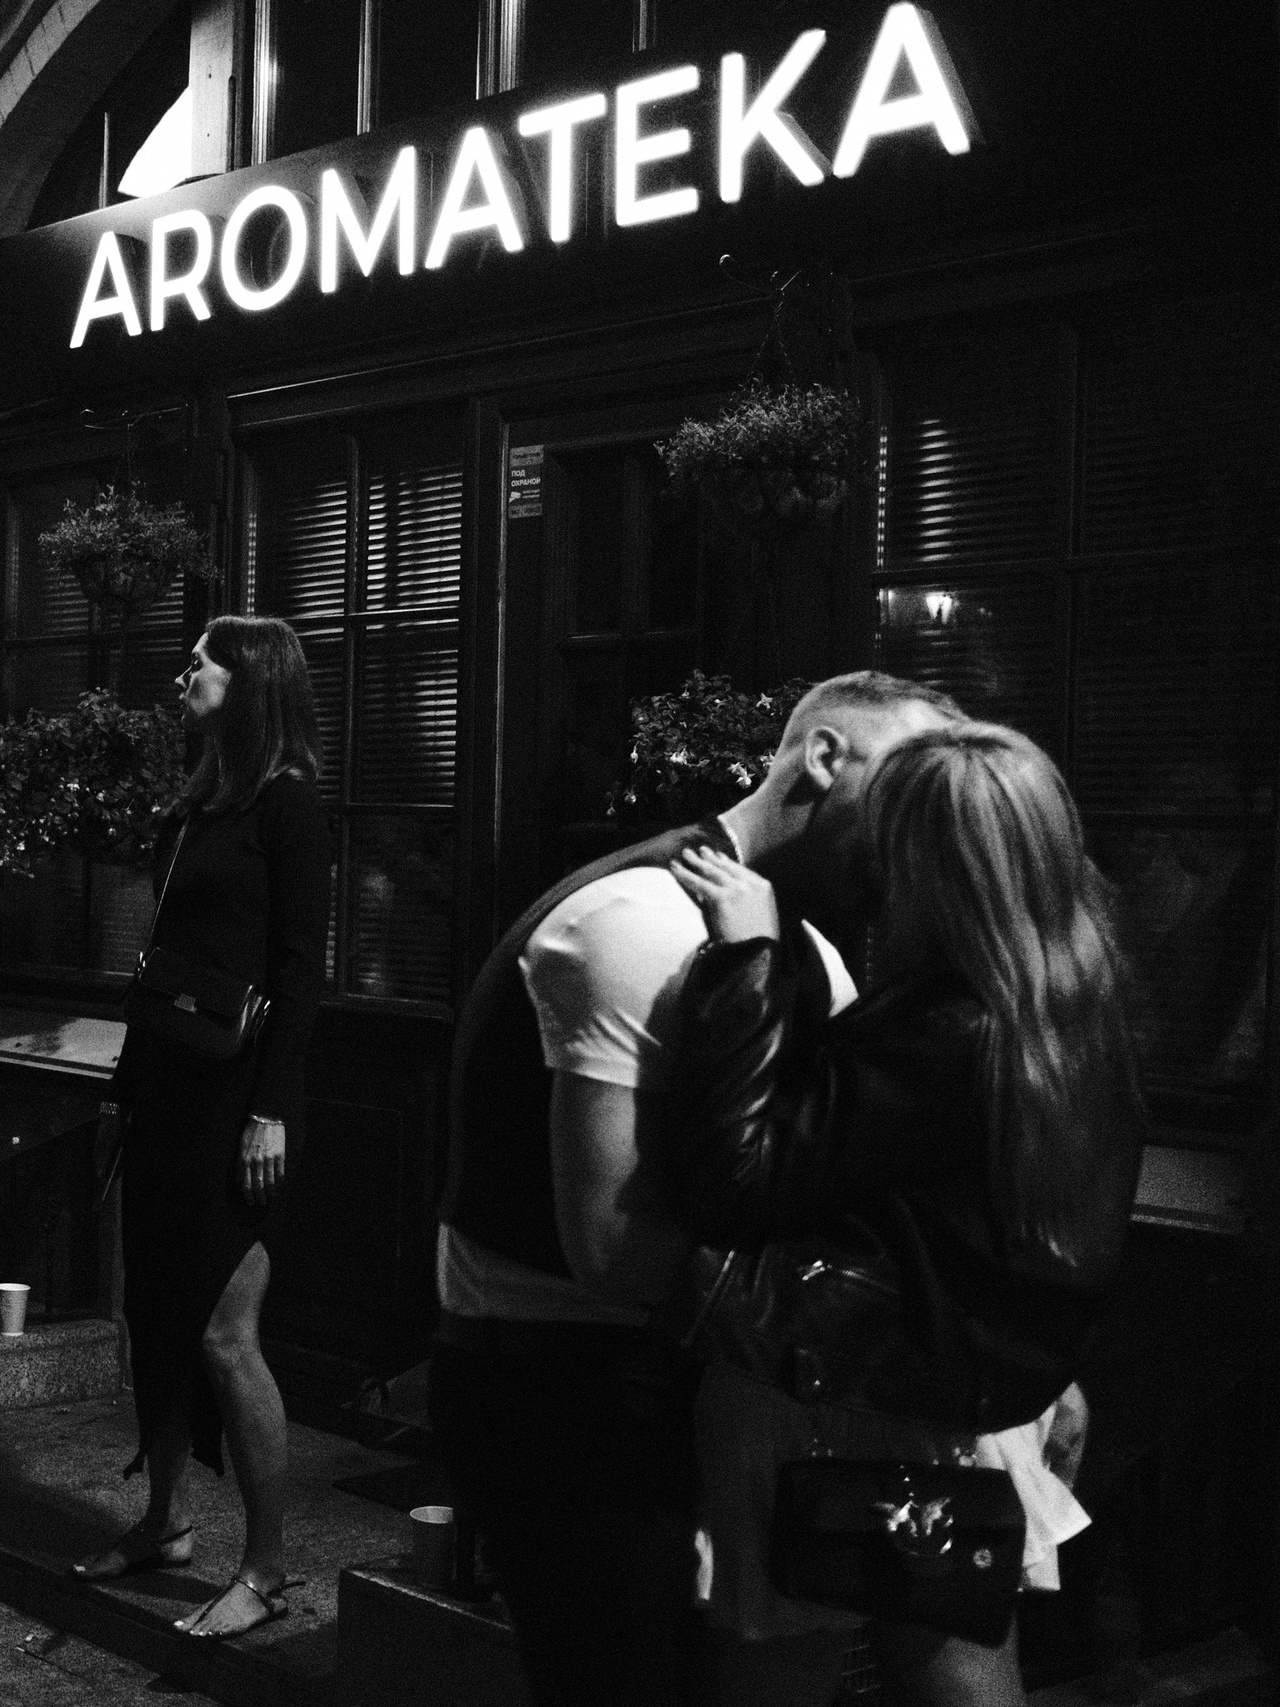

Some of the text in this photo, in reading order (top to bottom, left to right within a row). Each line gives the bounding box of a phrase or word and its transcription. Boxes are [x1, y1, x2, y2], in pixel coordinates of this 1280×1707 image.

[69, 2, 971, 349] AROMATEKA
[511, 469, 526, 477] ПОД
[511, 476, 541, 487] ОХРАНОЙ
